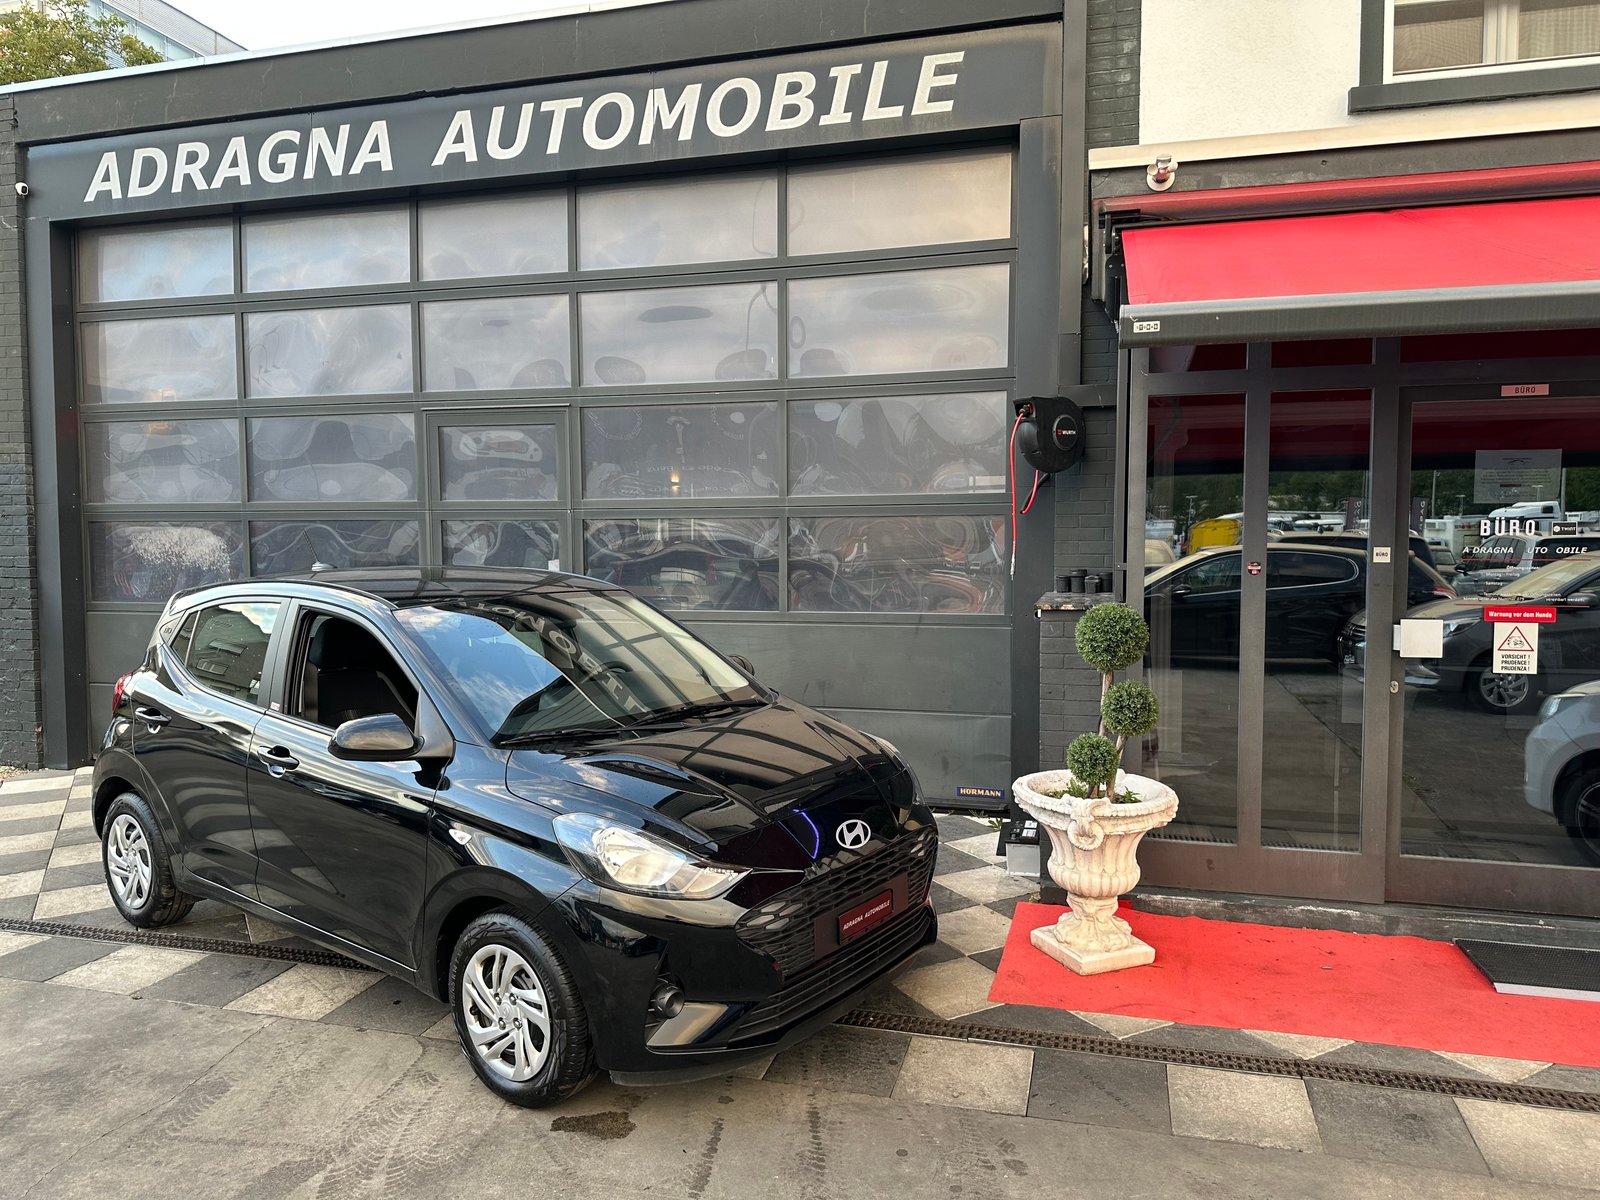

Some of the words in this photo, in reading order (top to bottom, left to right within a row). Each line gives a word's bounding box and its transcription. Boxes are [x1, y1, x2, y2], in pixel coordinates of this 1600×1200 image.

[84, 120, 394, 203] ADRAGNA
[432, 51, 965, 167] AUTOMOBILE
[1514, 386, 1536, 394] BÜRO
[1480, 516, 1535, 536] BÜRO
[1488, 611, 1512, 619] Warnung
[842, 914, 864, 931] ADRAGNA
[864, 900, 891, 919] AUTOMOBILE
